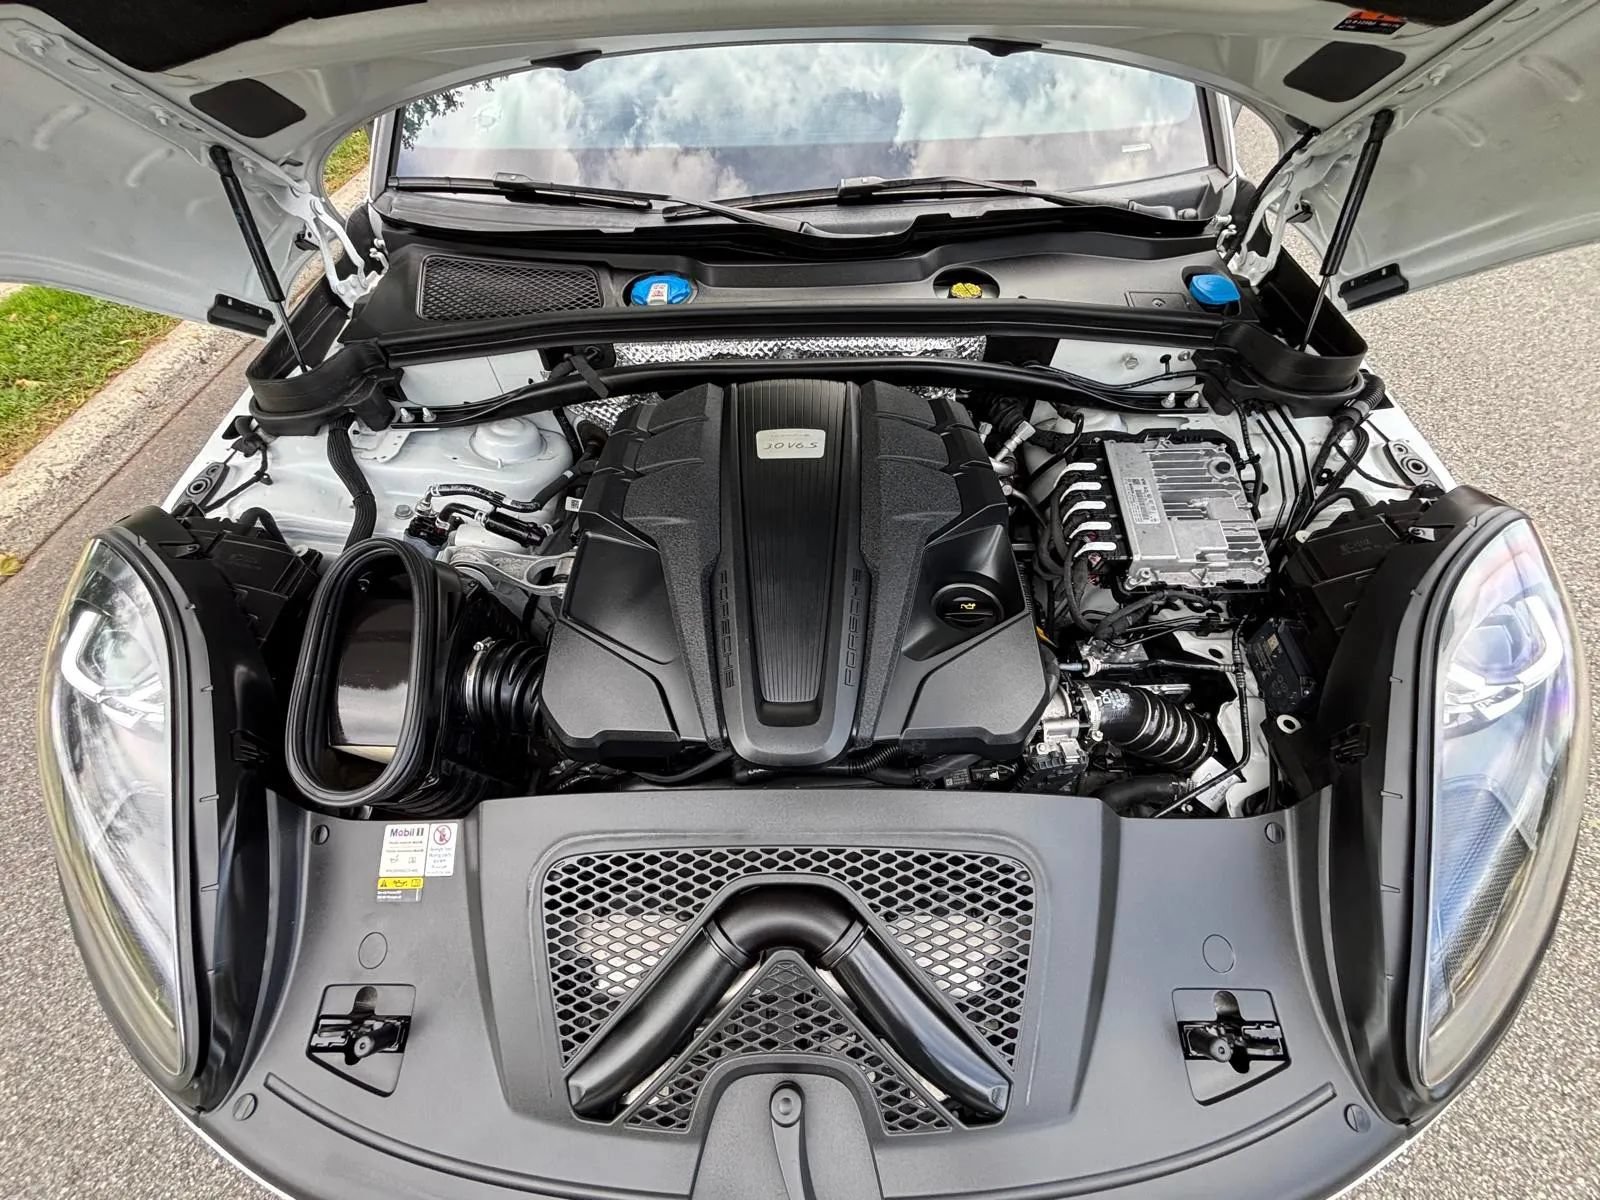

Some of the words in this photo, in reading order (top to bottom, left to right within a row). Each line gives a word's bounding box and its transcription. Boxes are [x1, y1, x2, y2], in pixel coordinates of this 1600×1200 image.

[719, 569, 735, 689] PORSCHE
[843, 567, 863, 687] PORSCHE
[390, 828, 415, 837] Mobil
